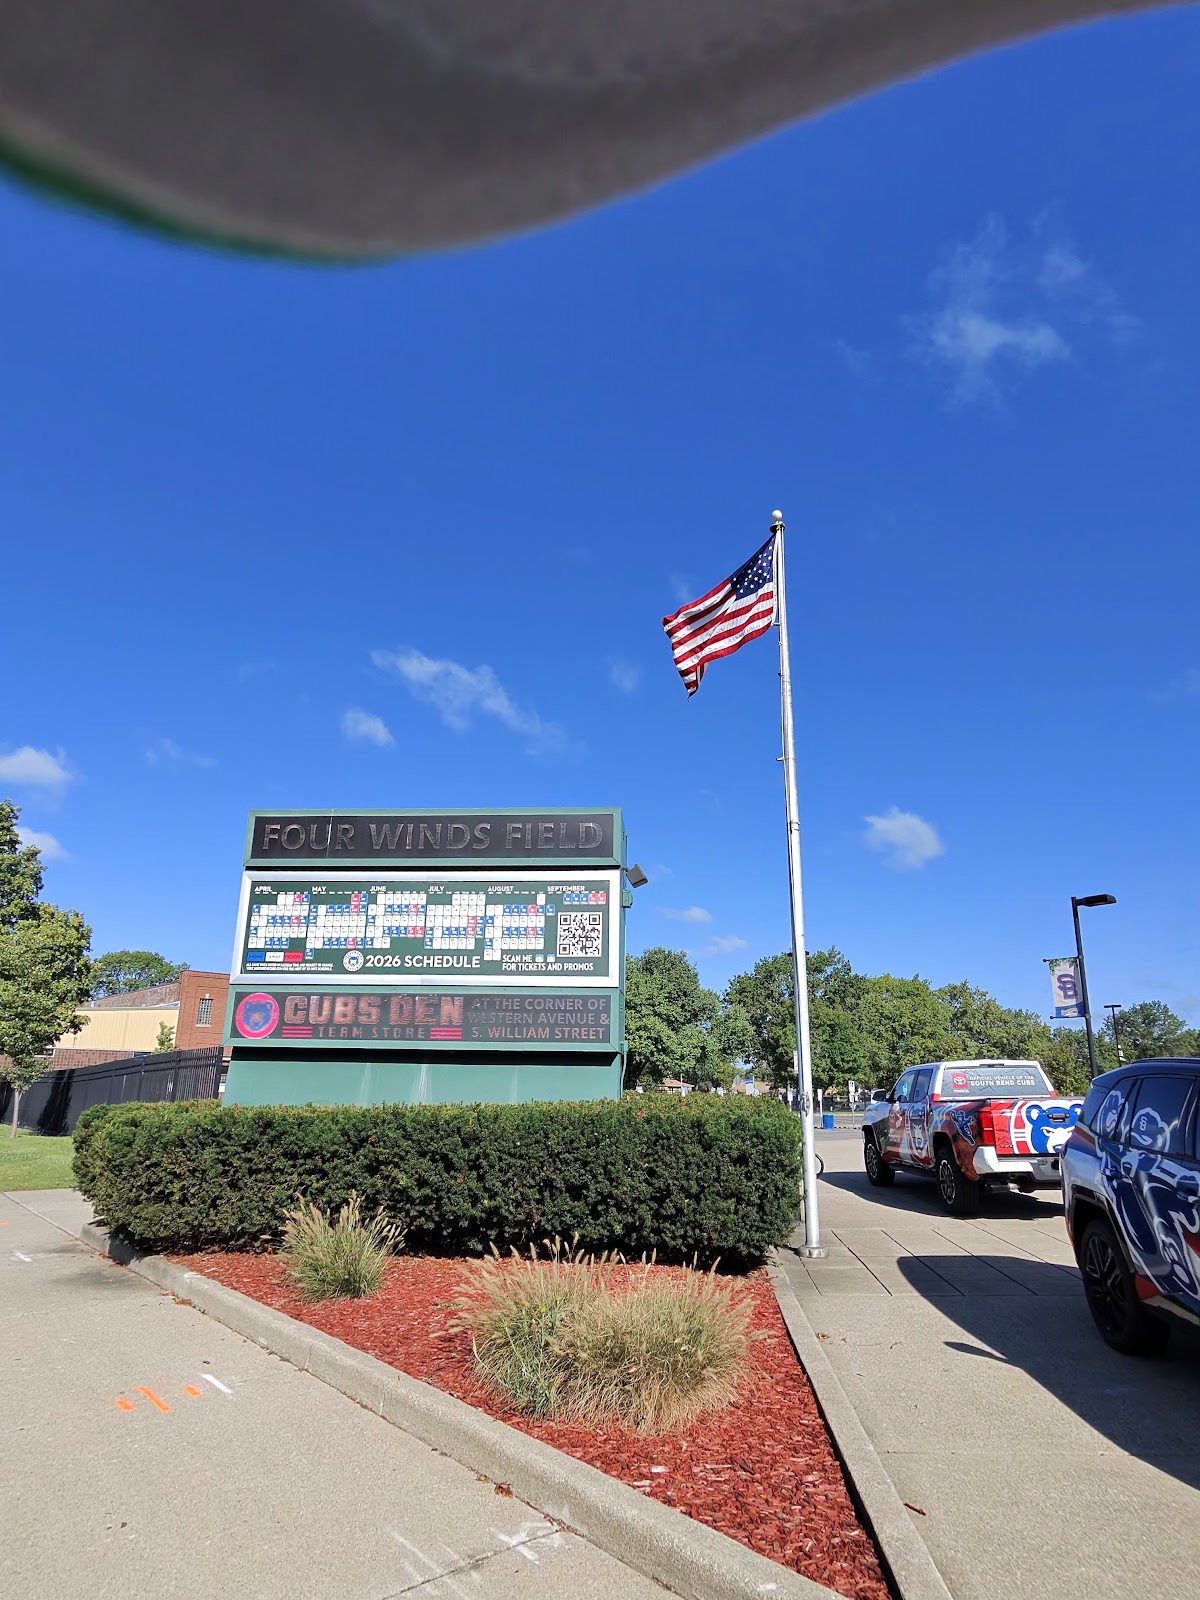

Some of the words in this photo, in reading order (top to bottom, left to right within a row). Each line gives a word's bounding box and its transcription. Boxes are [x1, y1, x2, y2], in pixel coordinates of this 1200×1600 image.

[262, 823, 355, 850] FOUR
[369, 823, 491, 850] WINDS
[505, 822, 603, 849] FIELD
[365, 955, 401, 968] 2026
[404, 956, 480, 968] SCHEDULE
[502, 955, 521, 963] SCAN
[502, 963, 516, 971] FOR
[517, 963, 546, 971] TICKETS
[547, 963, 562, 971] AND
[564, 963, 593, 971] PROMOS
[283, 995, 381, 1025] CUBS
[389, 996, 464, 1026] DEN
[472, 998, 490, 1010] AT
[493, 998, 520, 1010] THE
[525, 998, 583, 1010] CORNER
[587, 998, 607, 1010] OF
[467, 1012, 533, 1025] WESTERN
[538, 1012, 595, 1024] AVENUE
[600, 1013, 610, 1025] &
[318, 1027, 363, 1038] TEAM
[372, 1027, 426, 1039] STORE
[472, 1026, 483, 1038] S.
[488, 1027, 550, 1038] WILLIAM
[555, 1027, 605, 1039] STREET
